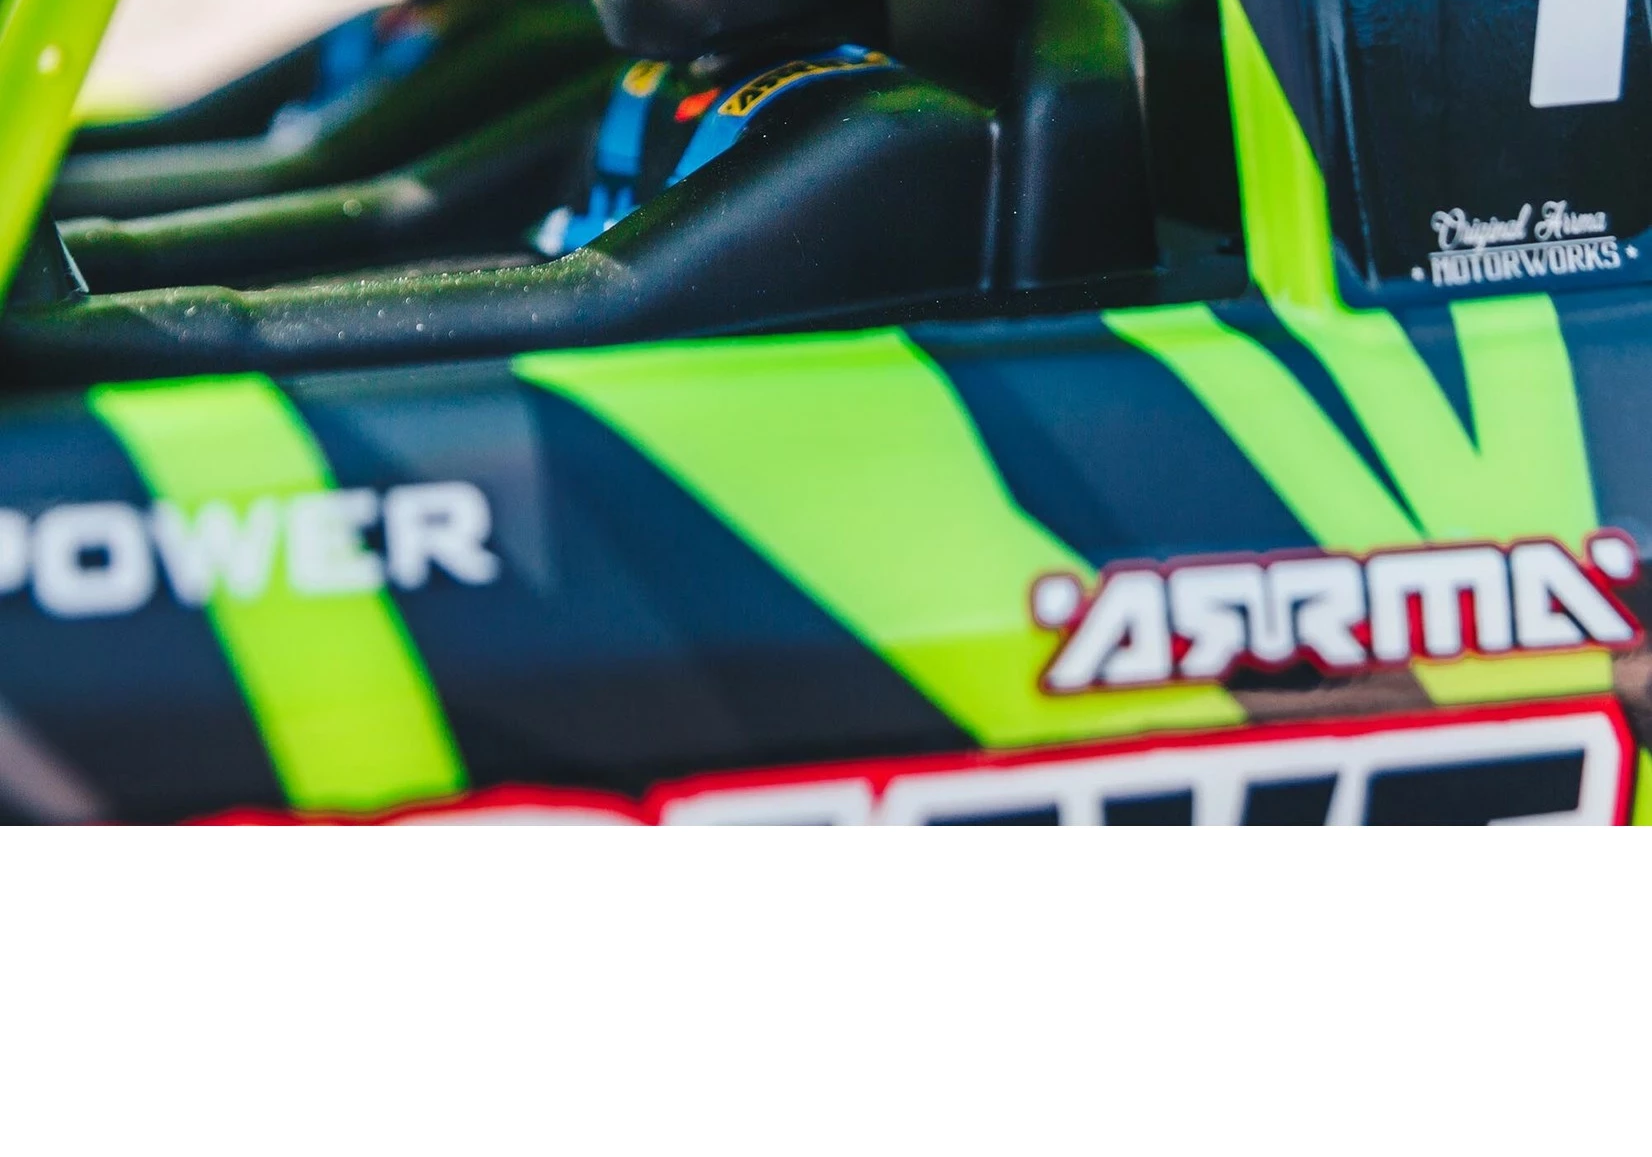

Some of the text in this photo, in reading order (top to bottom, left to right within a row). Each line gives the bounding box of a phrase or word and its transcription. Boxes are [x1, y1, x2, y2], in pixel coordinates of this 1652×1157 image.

[1430, 240, 1621, 287] MOTORWORKS
[0, 480, 500, 620] OWER
[1034, 536, 1634, 692] ARRMA
